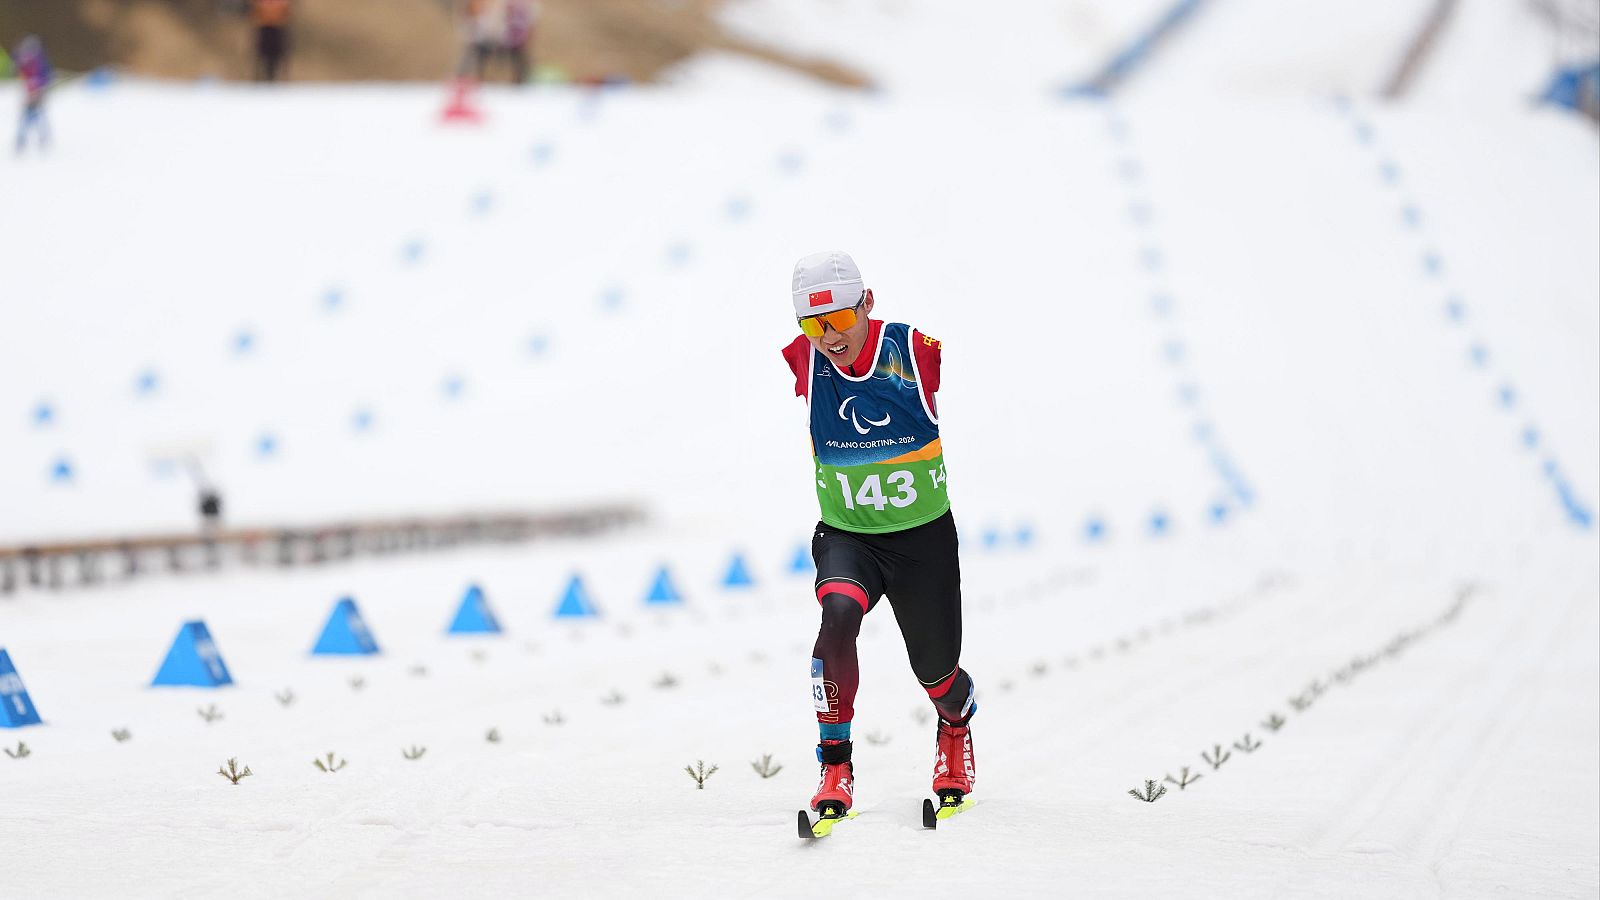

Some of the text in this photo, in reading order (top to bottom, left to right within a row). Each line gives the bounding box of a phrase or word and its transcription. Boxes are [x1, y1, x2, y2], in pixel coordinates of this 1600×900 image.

[825, 435, 916, 449] MILANO CORTINA 2026
[835, 469, 918, 511] 143
